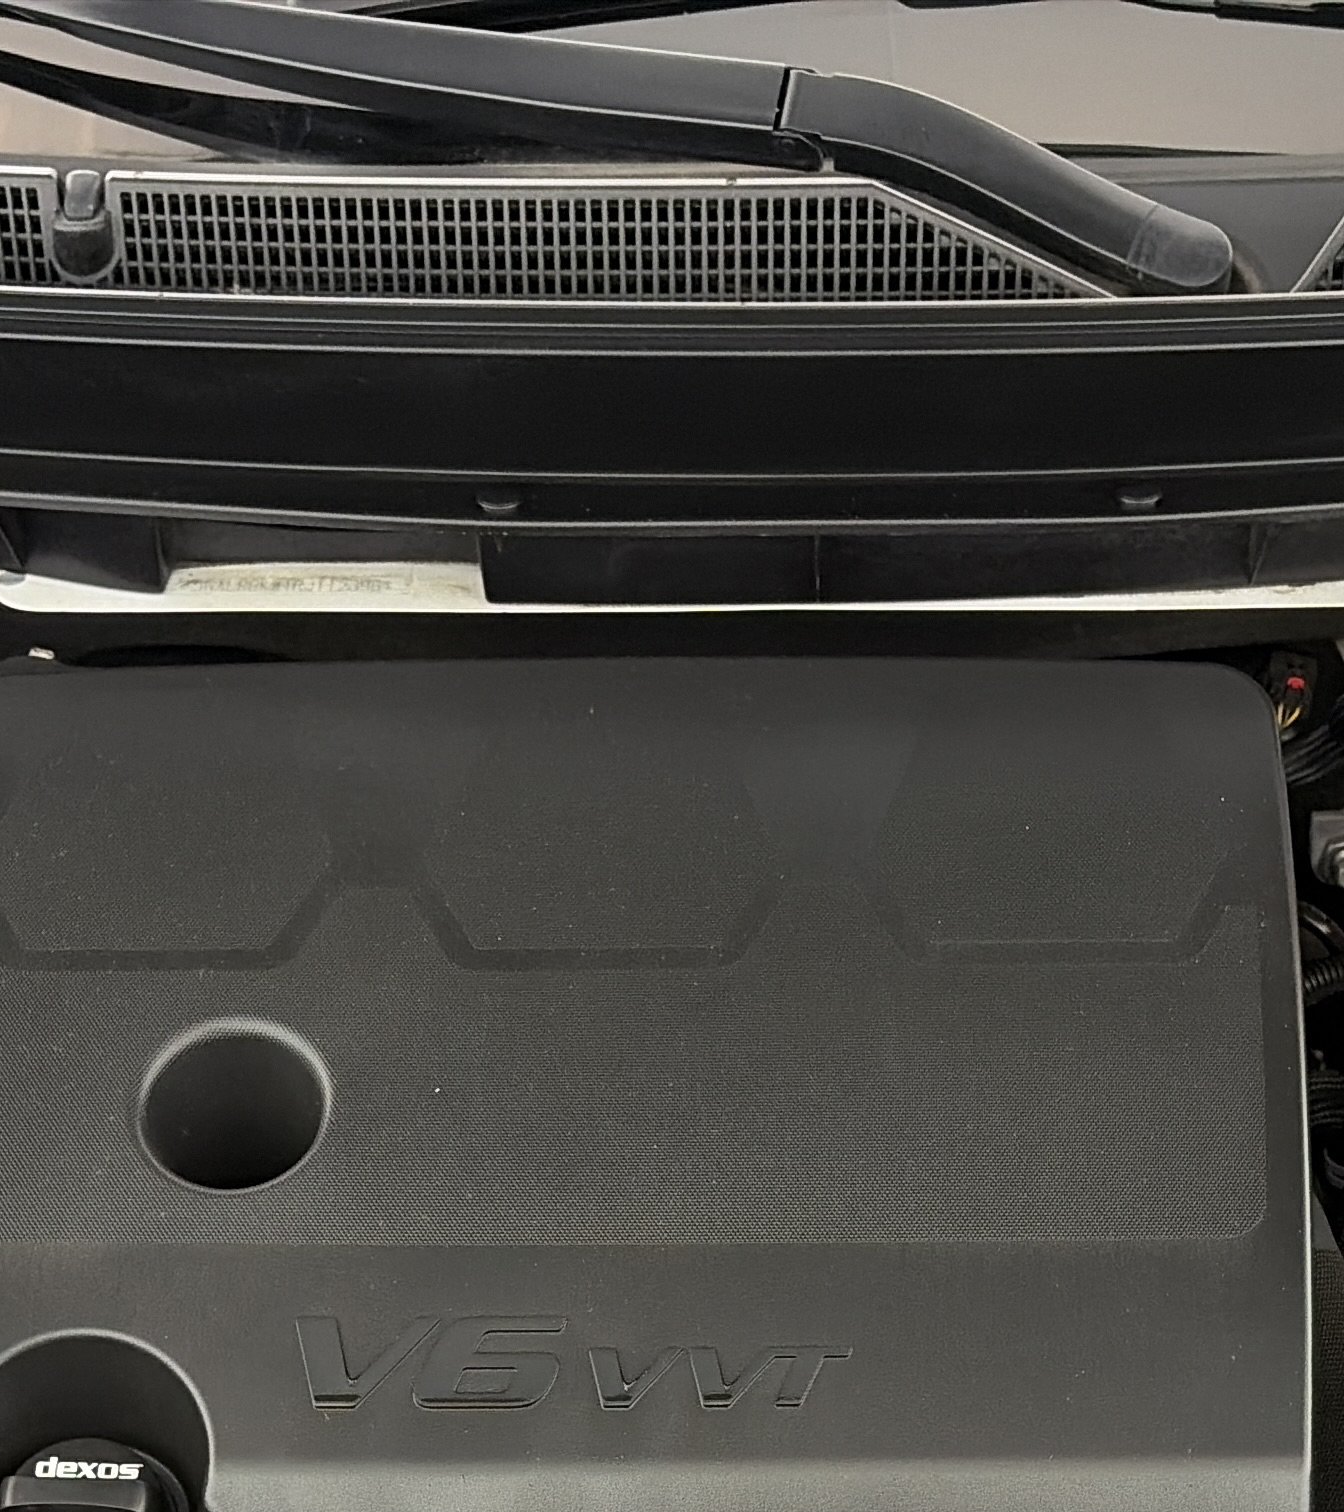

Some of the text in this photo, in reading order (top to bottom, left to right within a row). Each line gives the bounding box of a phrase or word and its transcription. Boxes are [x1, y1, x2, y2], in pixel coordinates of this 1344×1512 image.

[295, 1315, 853, 1410] V6 VVT
[34, 1456, 141, 1480] dexos
